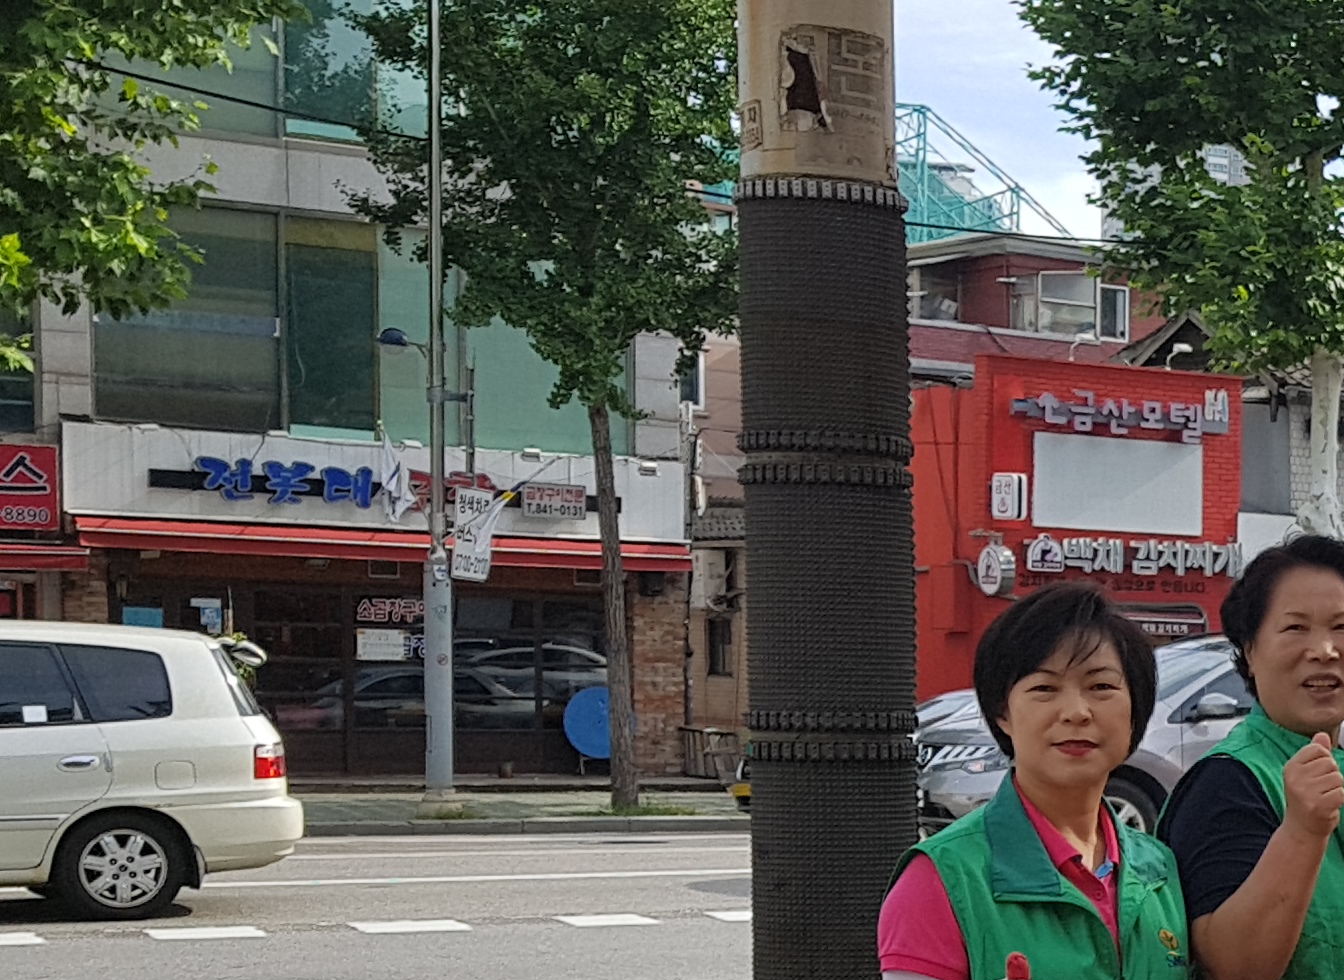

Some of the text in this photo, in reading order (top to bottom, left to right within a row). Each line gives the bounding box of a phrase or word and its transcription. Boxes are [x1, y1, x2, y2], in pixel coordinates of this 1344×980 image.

[1069, 389, 1203, 444] 금산모텔
[194, 456, 373, 510] 전봇대
[526, 503, 583, 517] T.841-0131
[1063, 537, 1242, 578] 백채 김치찌개
